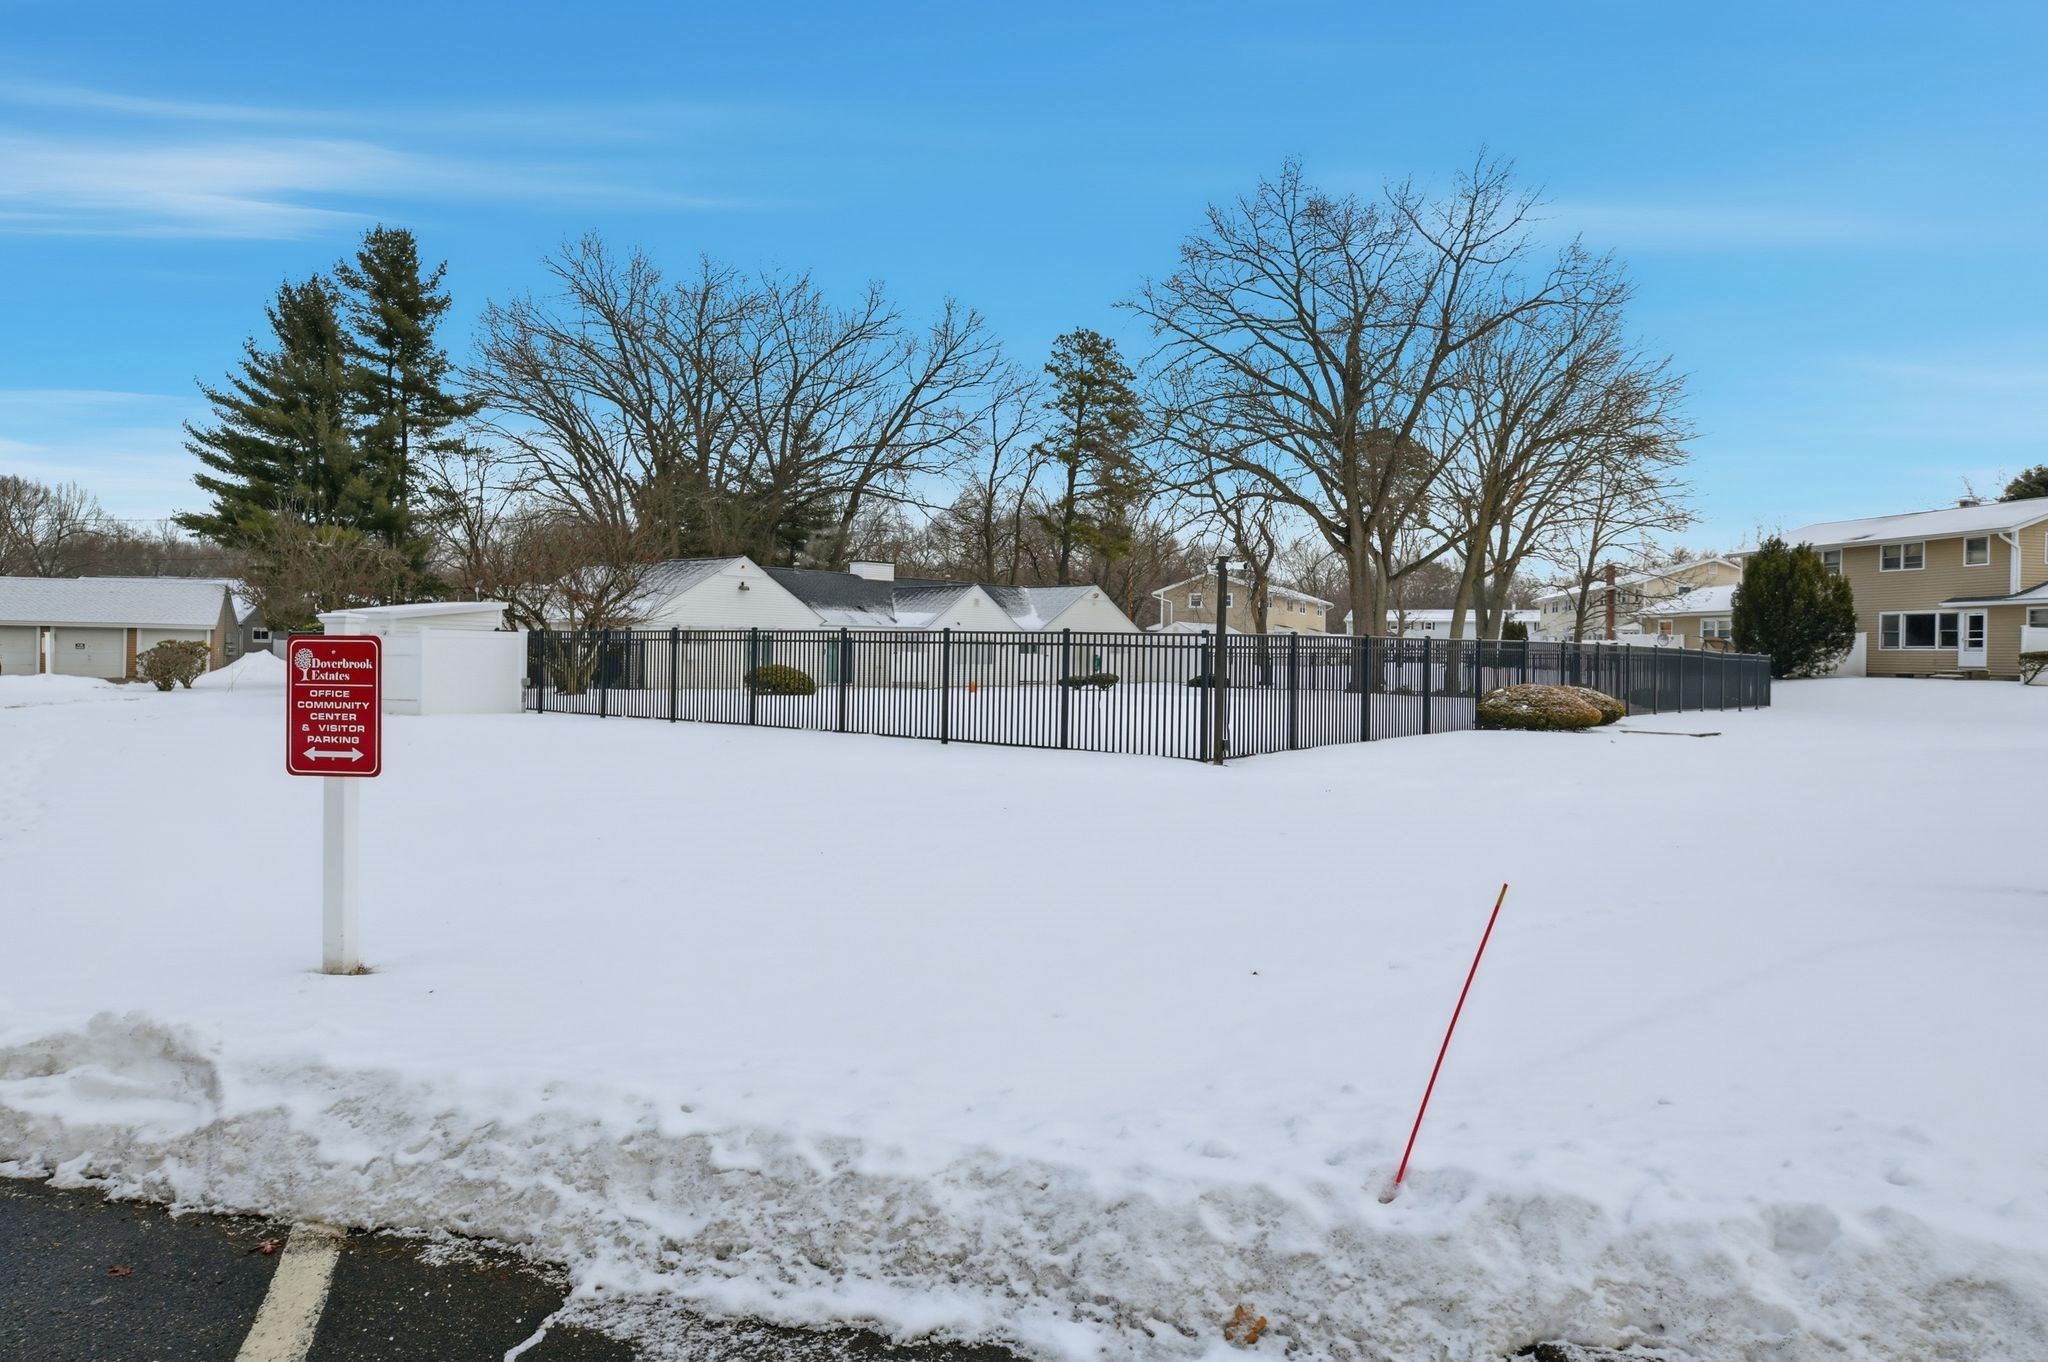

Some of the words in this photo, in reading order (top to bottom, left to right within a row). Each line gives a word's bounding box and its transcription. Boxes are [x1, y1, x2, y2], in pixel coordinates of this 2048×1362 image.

[311, 658, 373, 669] Doverbrook
[311, 670, 350, 681] Estates
[309, 689, 350, 698] OFFICE
[297, 701, 370, 710] COMMUNITY
[310, 712, 357, 721] CENTER
[301, 723, 310, 732] &
[318, 724, 365, 733] VISITOR
[307, 735, 360, 744] PARKING
